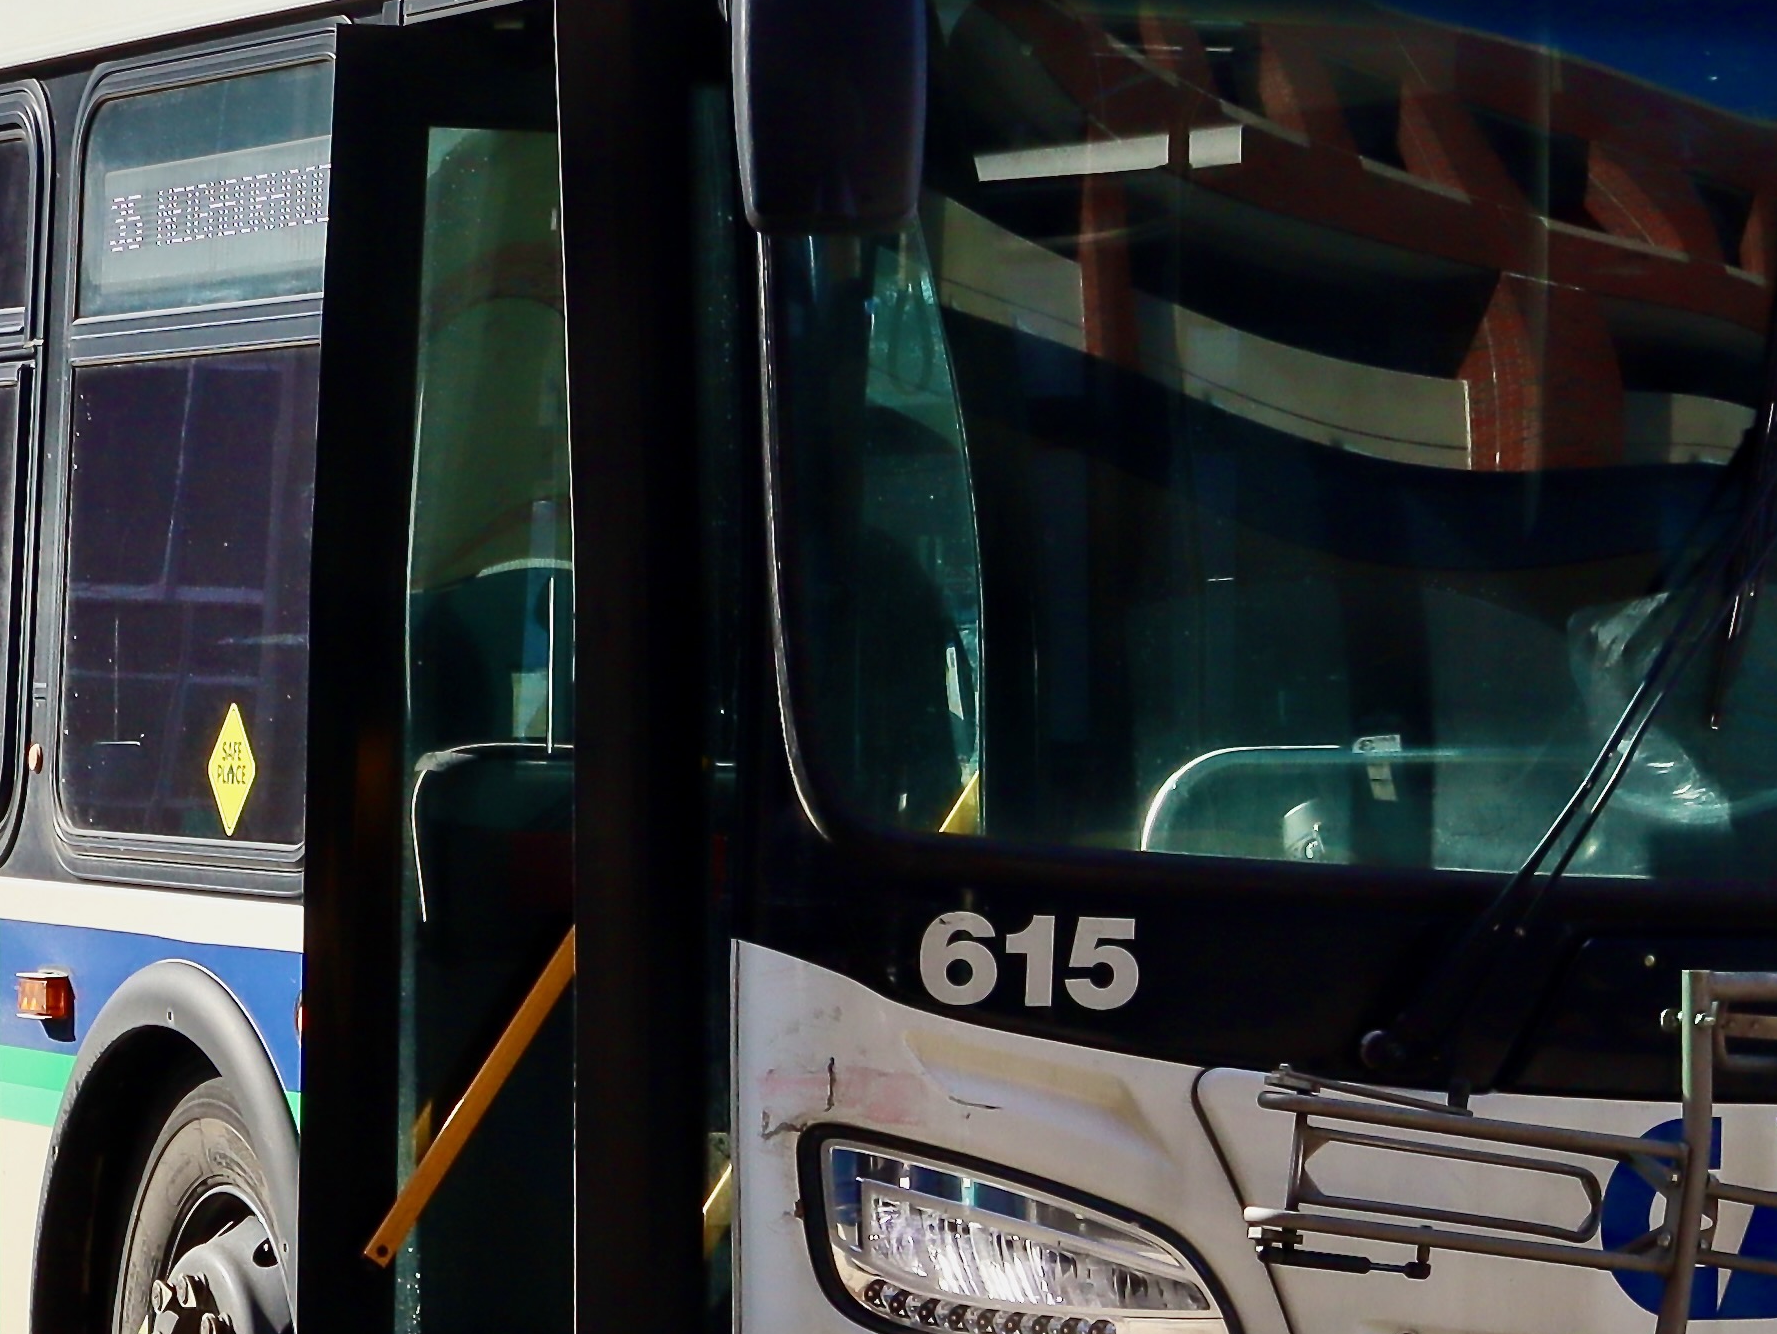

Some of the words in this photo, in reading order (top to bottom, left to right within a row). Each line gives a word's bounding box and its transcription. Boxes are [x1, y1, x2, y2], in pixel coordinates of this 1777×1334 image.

[110, 195, 142, 252] 35
[221, 741, 242, 762] SAFE
[217, 764, 246, 785] PLACE
[920, 911, 1139, 1010] 615
